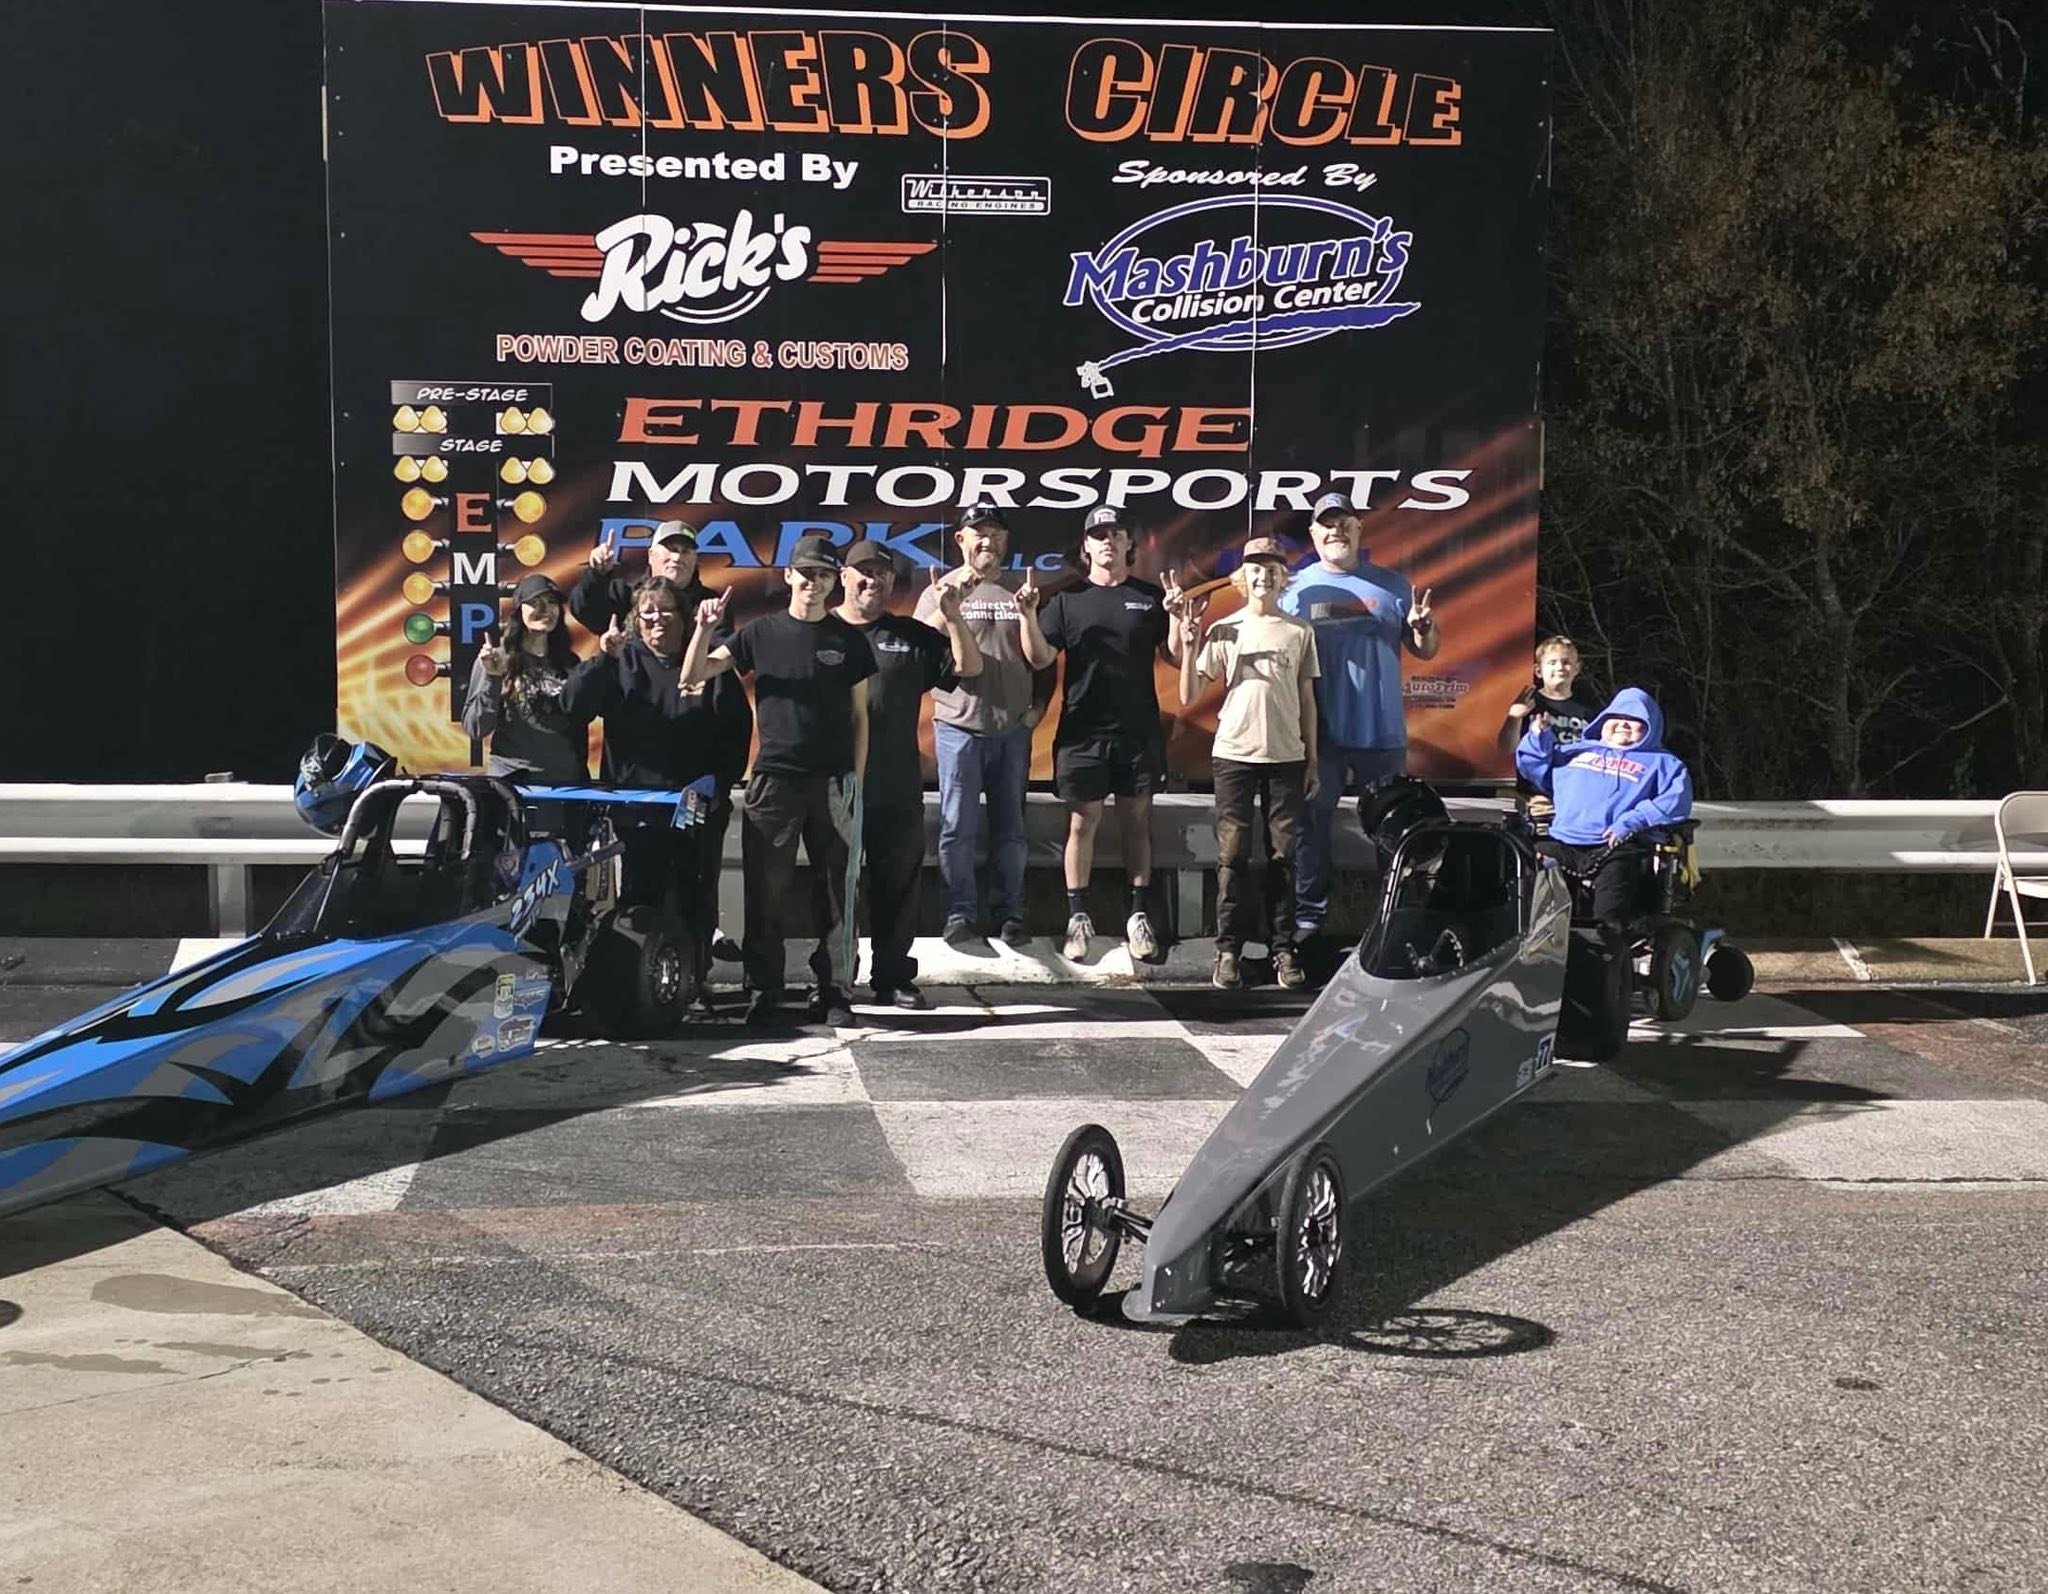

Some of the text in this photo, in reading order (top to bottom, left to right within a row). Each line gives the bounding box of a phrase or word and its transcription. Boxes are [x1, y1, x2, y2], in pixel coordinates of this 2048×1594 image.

[426, 30, 1462, 145] WINNERS CIRCLE
[550, 145, 859, 189] Presented By
[1112, 160, 1378, 191] Sponsored By
[580, 209, 811, 321] Rick's
[1063, 216, 1413, 306] Mashburn's
[1131, 279, 1379, 325] Collision Center
[496, 334, 909, 371] POWDER COATING & CUSTOMS
[417, 387, 529, 404] PRE-STAGE
[440, 438, 503, 454] STAGE
[618, 397, 1252, 458] ETHRIDGE
[606, 461, 1475, 511] MOTORSPORTS
